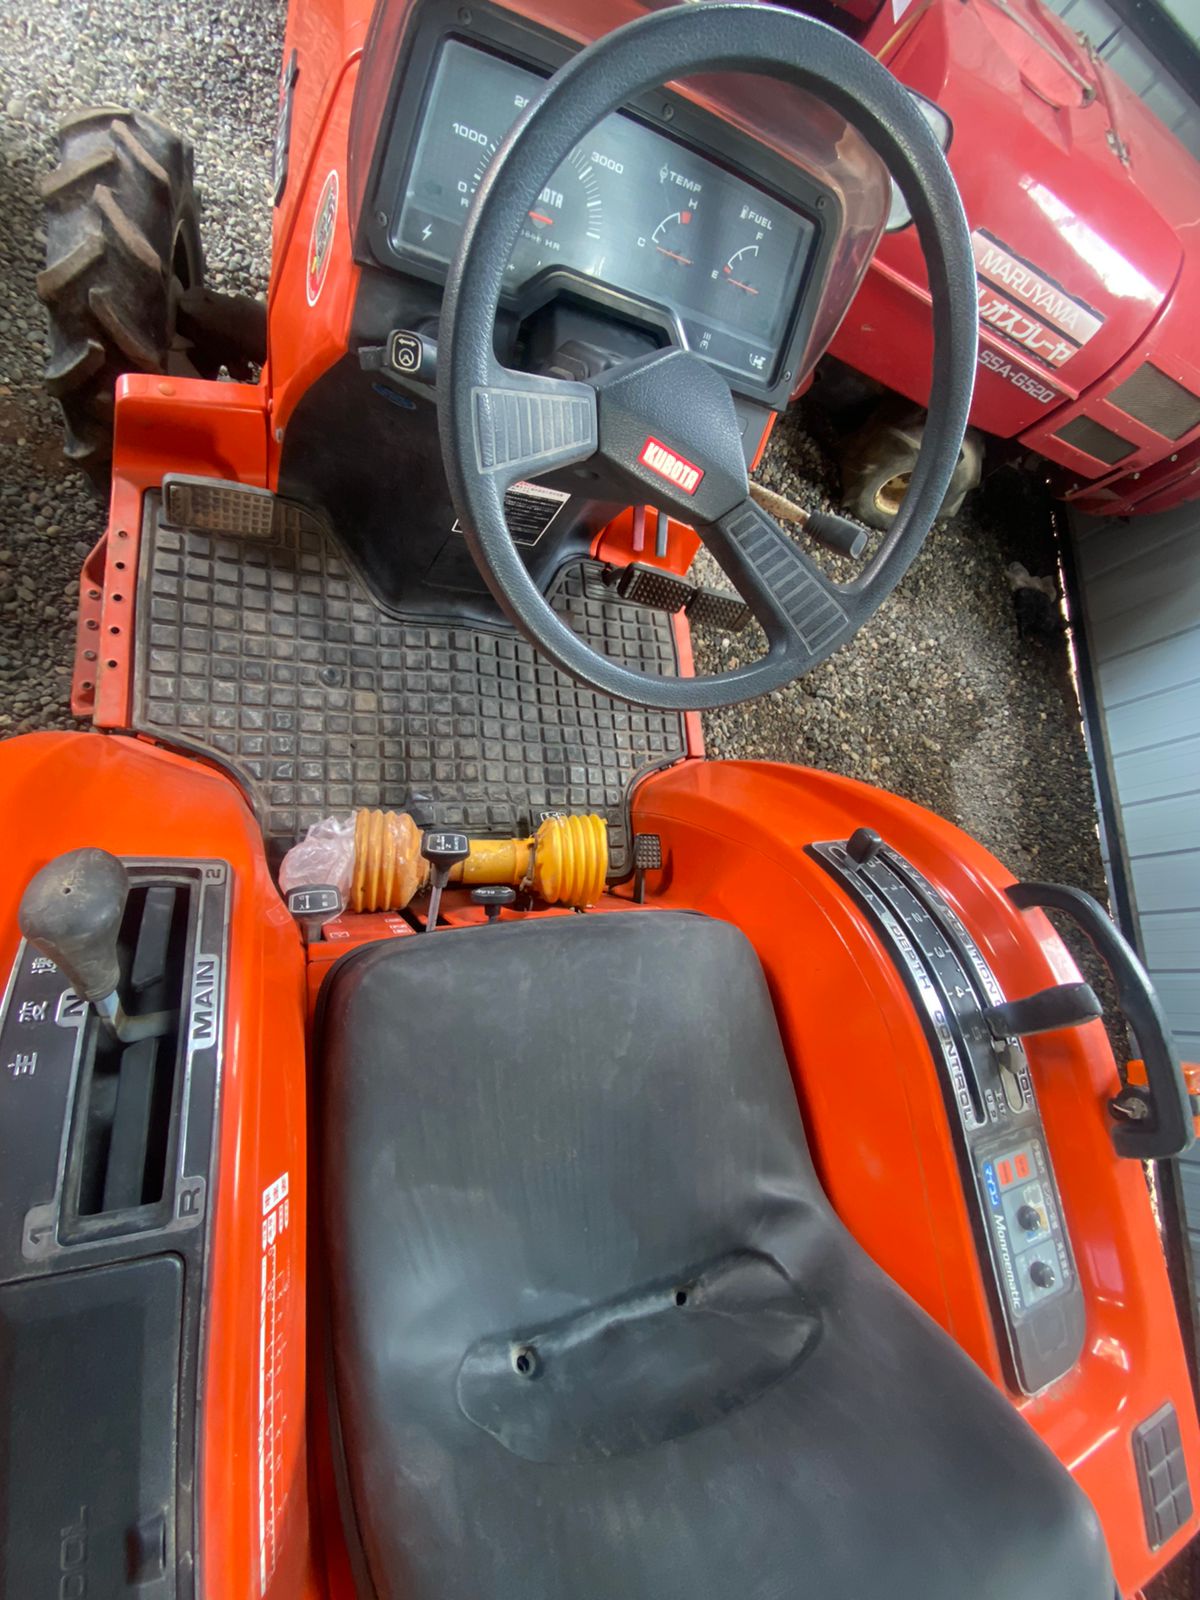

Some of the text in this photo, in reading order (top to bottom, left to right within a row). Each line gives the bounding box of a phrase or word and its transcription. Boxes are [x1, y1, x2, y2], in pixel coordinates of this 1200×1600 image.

[452, 122, 488, 146] 1000
[590, 151, 624, 175] 3000
[458, 180, 468, 193] 0
[669, 171, 702, 193] TEMP
[688, 198, 698, 210] H
[748, 211, 773, 231] FUEL
[637, 236, 647, 248] C
[755, 231, 764, 241] F
[711, 269, 719, 280] E
[980, 249, 1079, 331] MARUYAMA
[977, 287, 1072, 361] レオスプレーヤ
[642, 441, 700, 491] KUBOTA
[205, 867, 222, 881] 2
[913, 912, 924, 923] 2
[933, 945, 944, 959] 3
[192, 960, 216, 1040] MAIN
[954, 985, 965, 998] 4
[61, 994, 88, 1018] N
[892, 922, 973, 1121] DEPTH CONTROL
[984, 1165, 999, 1206] マイコン
[178, 1187, 201, 1218] R
[28, 1226, 54, 1246] 1
[993, 1213, 1022, 1310] Monroematic
[60, 1504, 89, 1600] OOL
